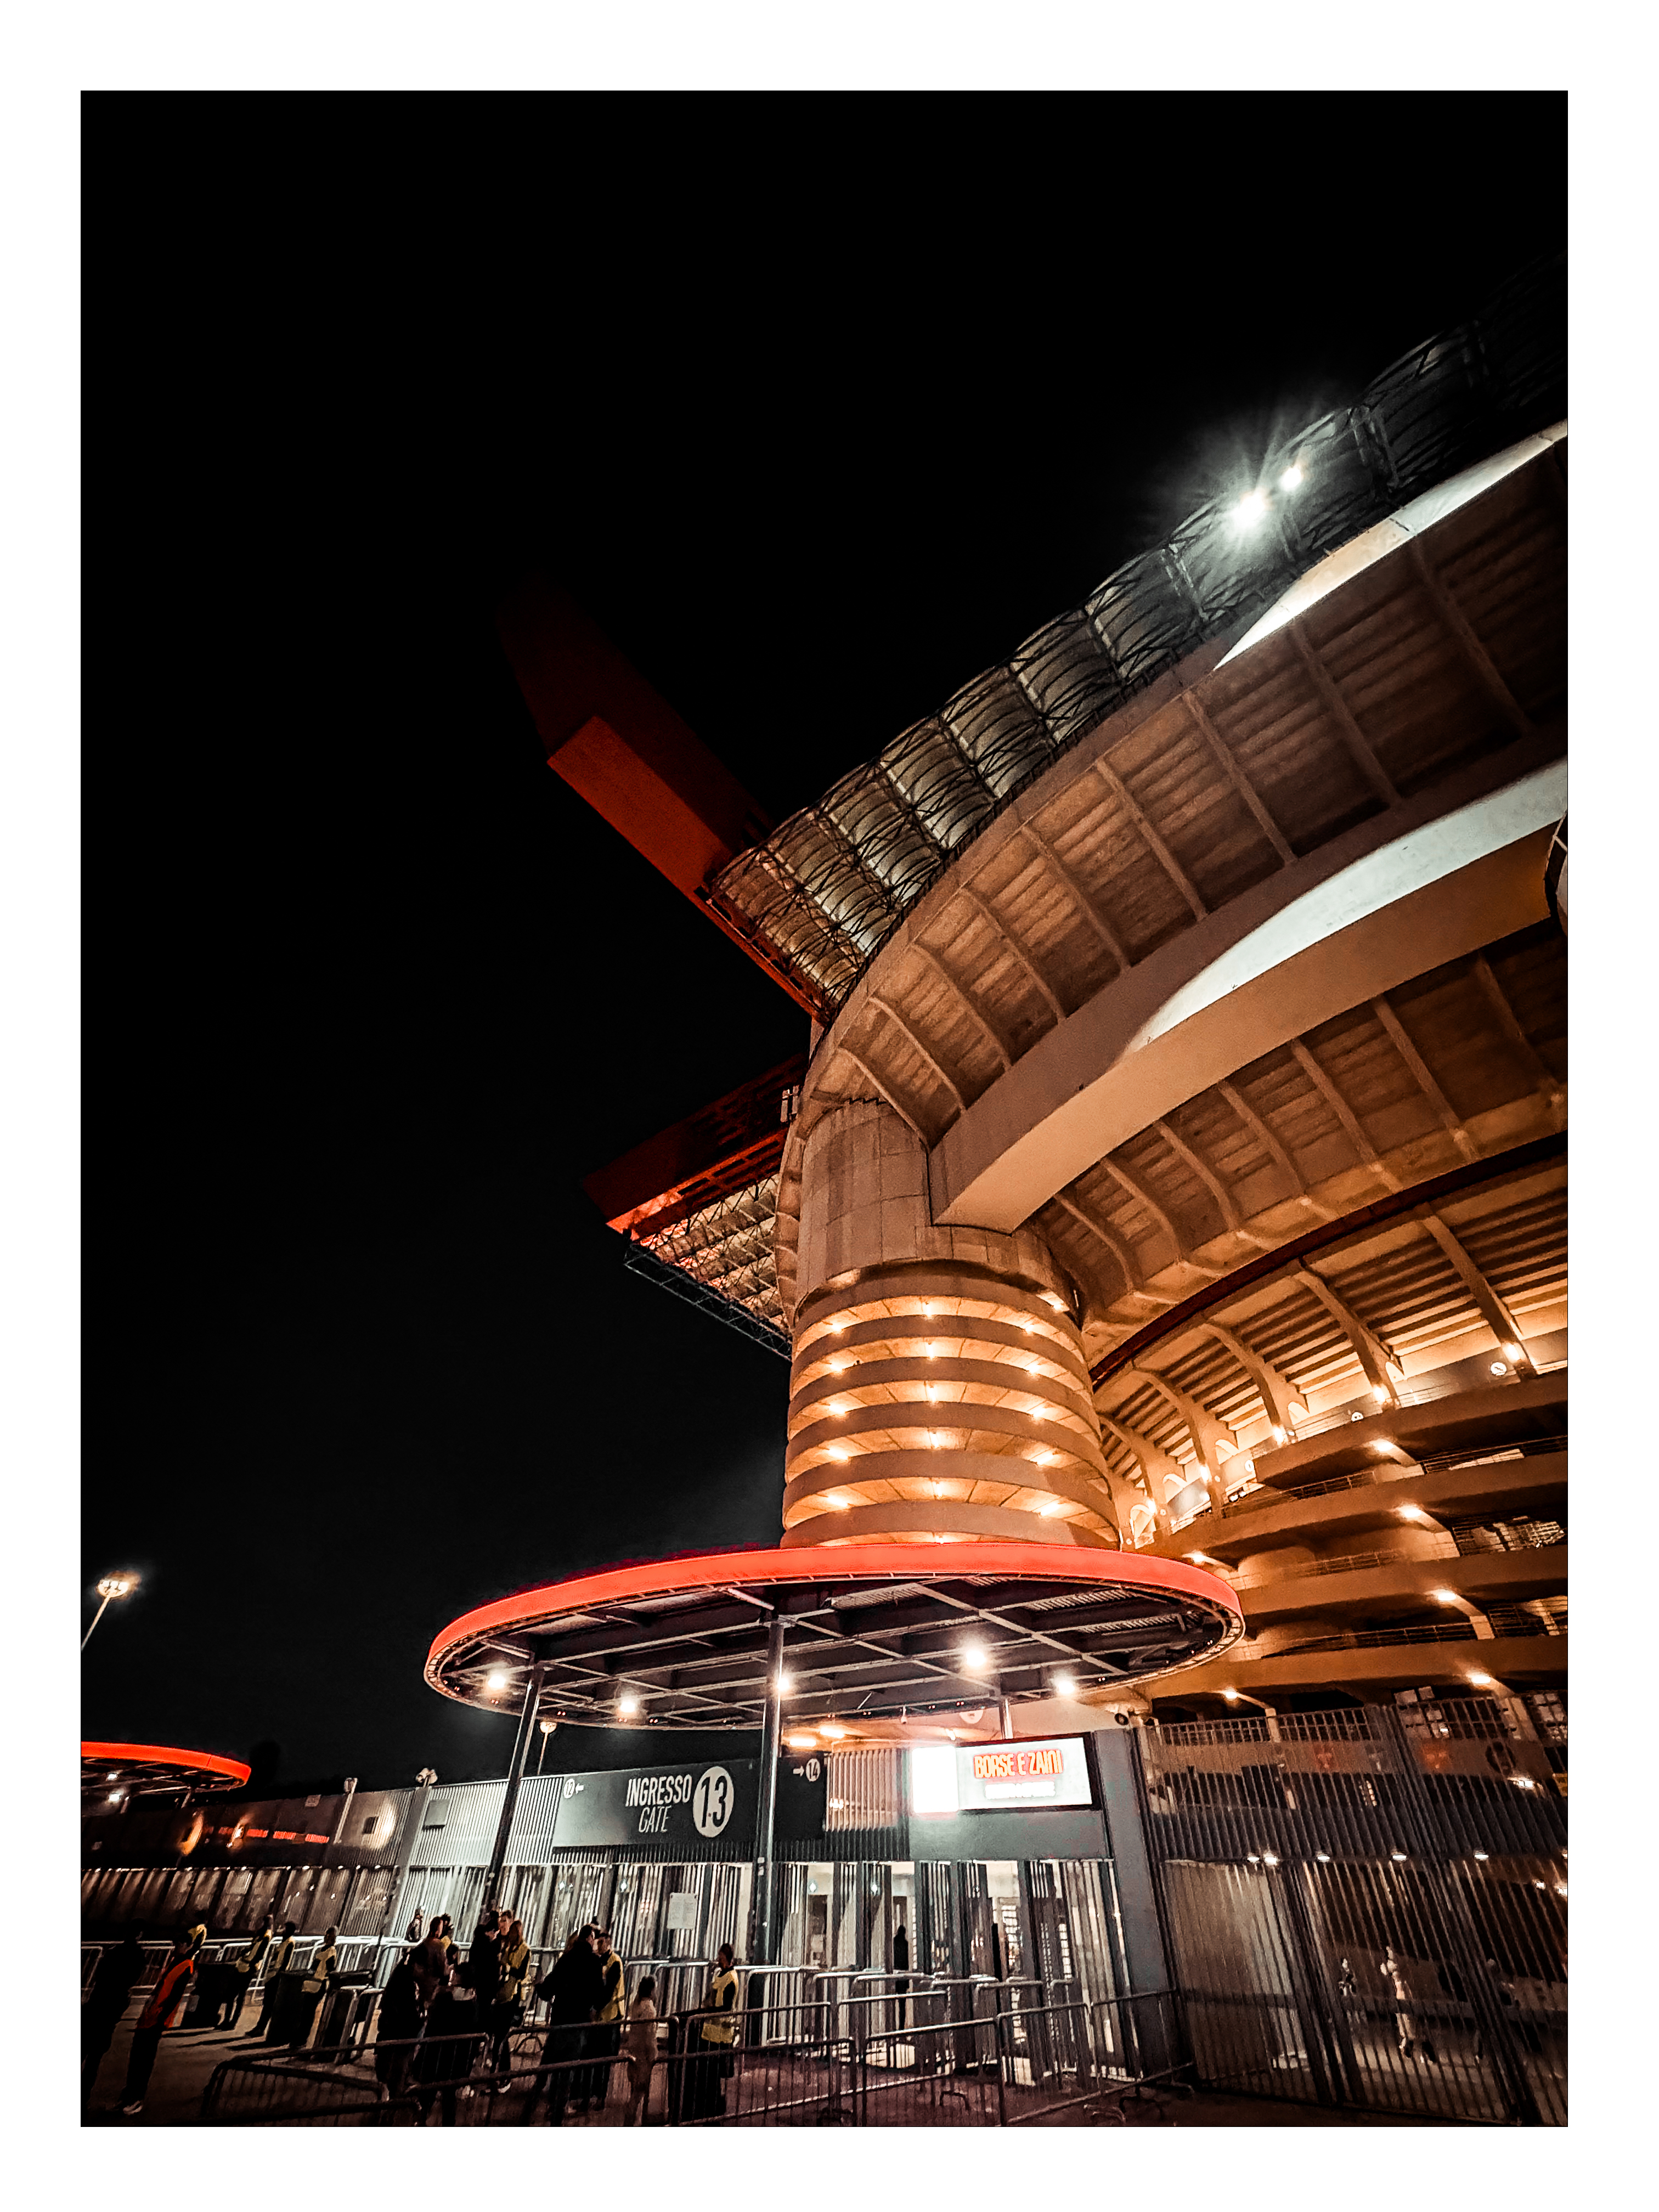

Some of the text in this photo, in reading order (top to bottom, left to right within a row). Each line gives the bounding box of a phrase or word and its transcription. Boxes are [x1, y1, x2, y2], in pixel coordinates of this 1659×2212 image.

[974, 1750, 1063, 1779] BORSE E ZAINI
[625, 1774, 692, 1807] INGRESSO
[701, 1775, 727, 1828] 13
[639, 1805, 672, 1833] GATE
